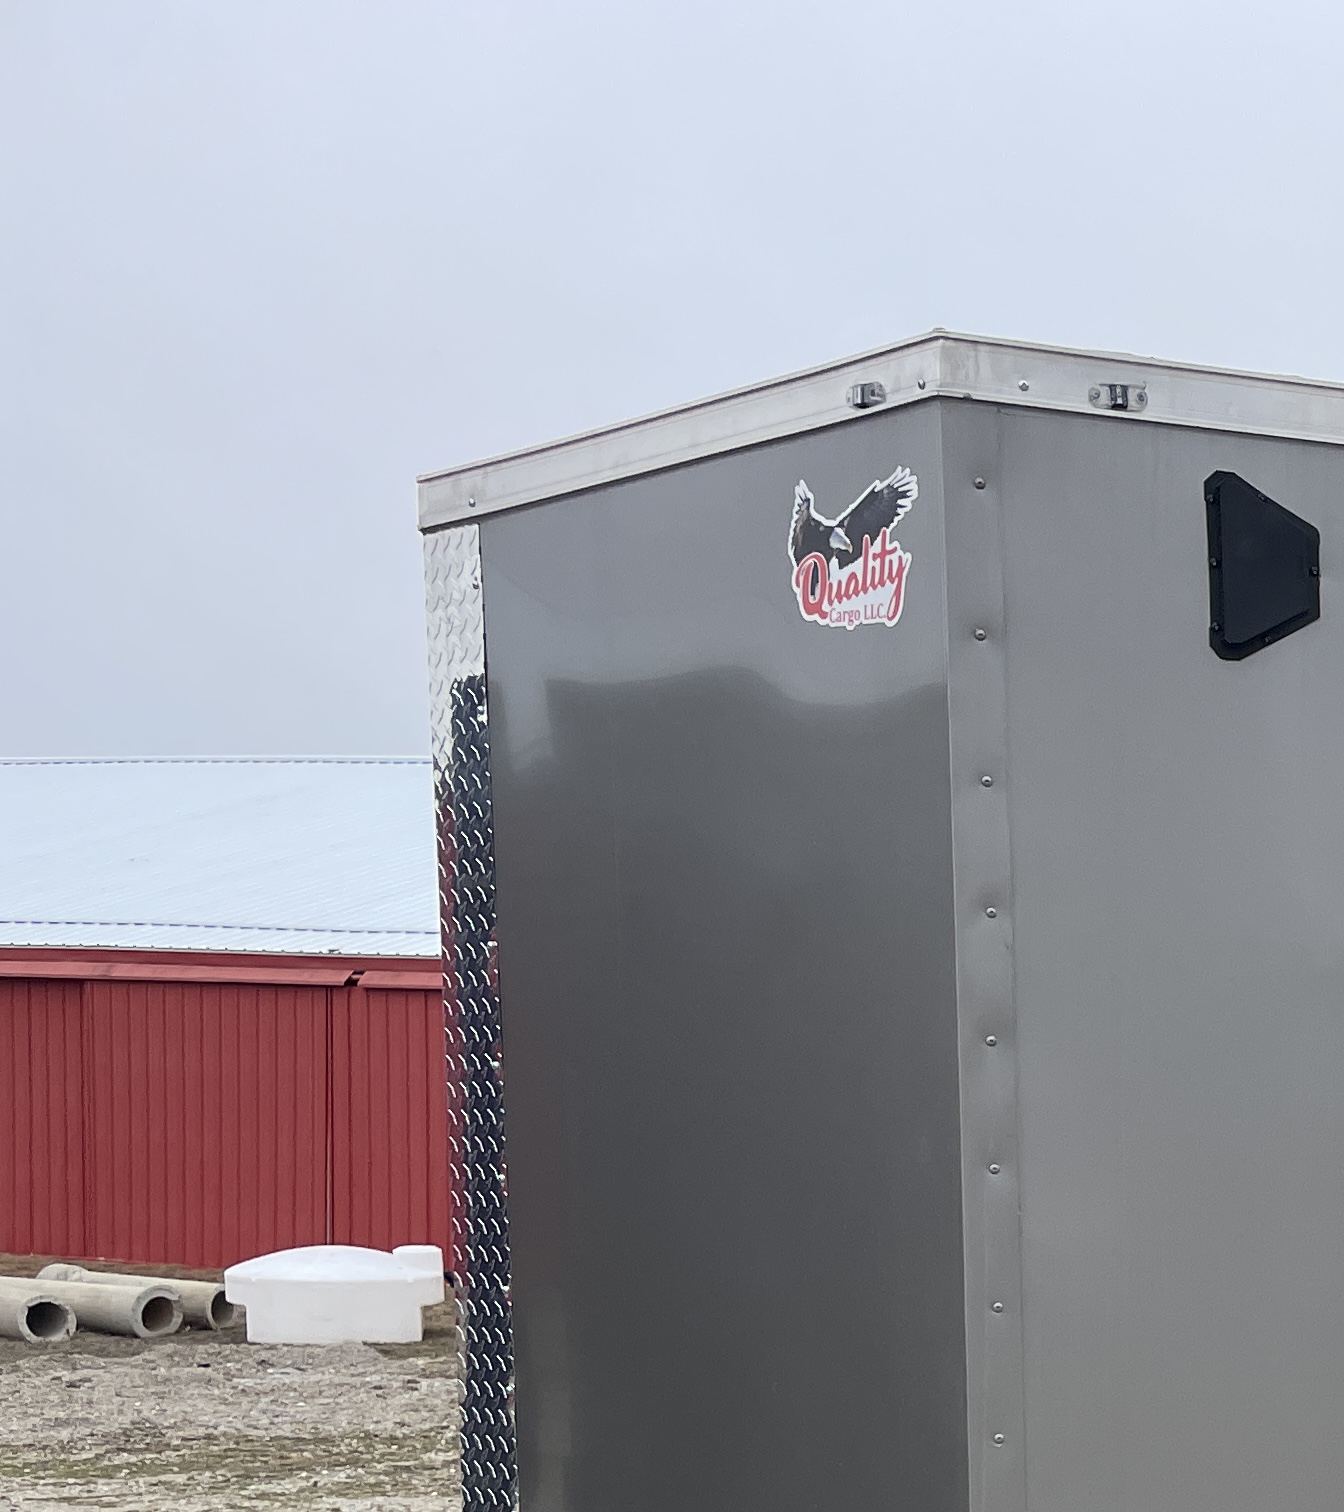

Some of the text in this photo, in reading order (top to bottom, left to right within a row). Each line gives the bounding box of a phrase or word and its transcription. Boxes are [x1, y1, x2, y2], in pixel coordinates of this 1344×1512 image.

[795, 527, 906, 621] Quality
[829, 603, 887, 626] Cargo LLC.
